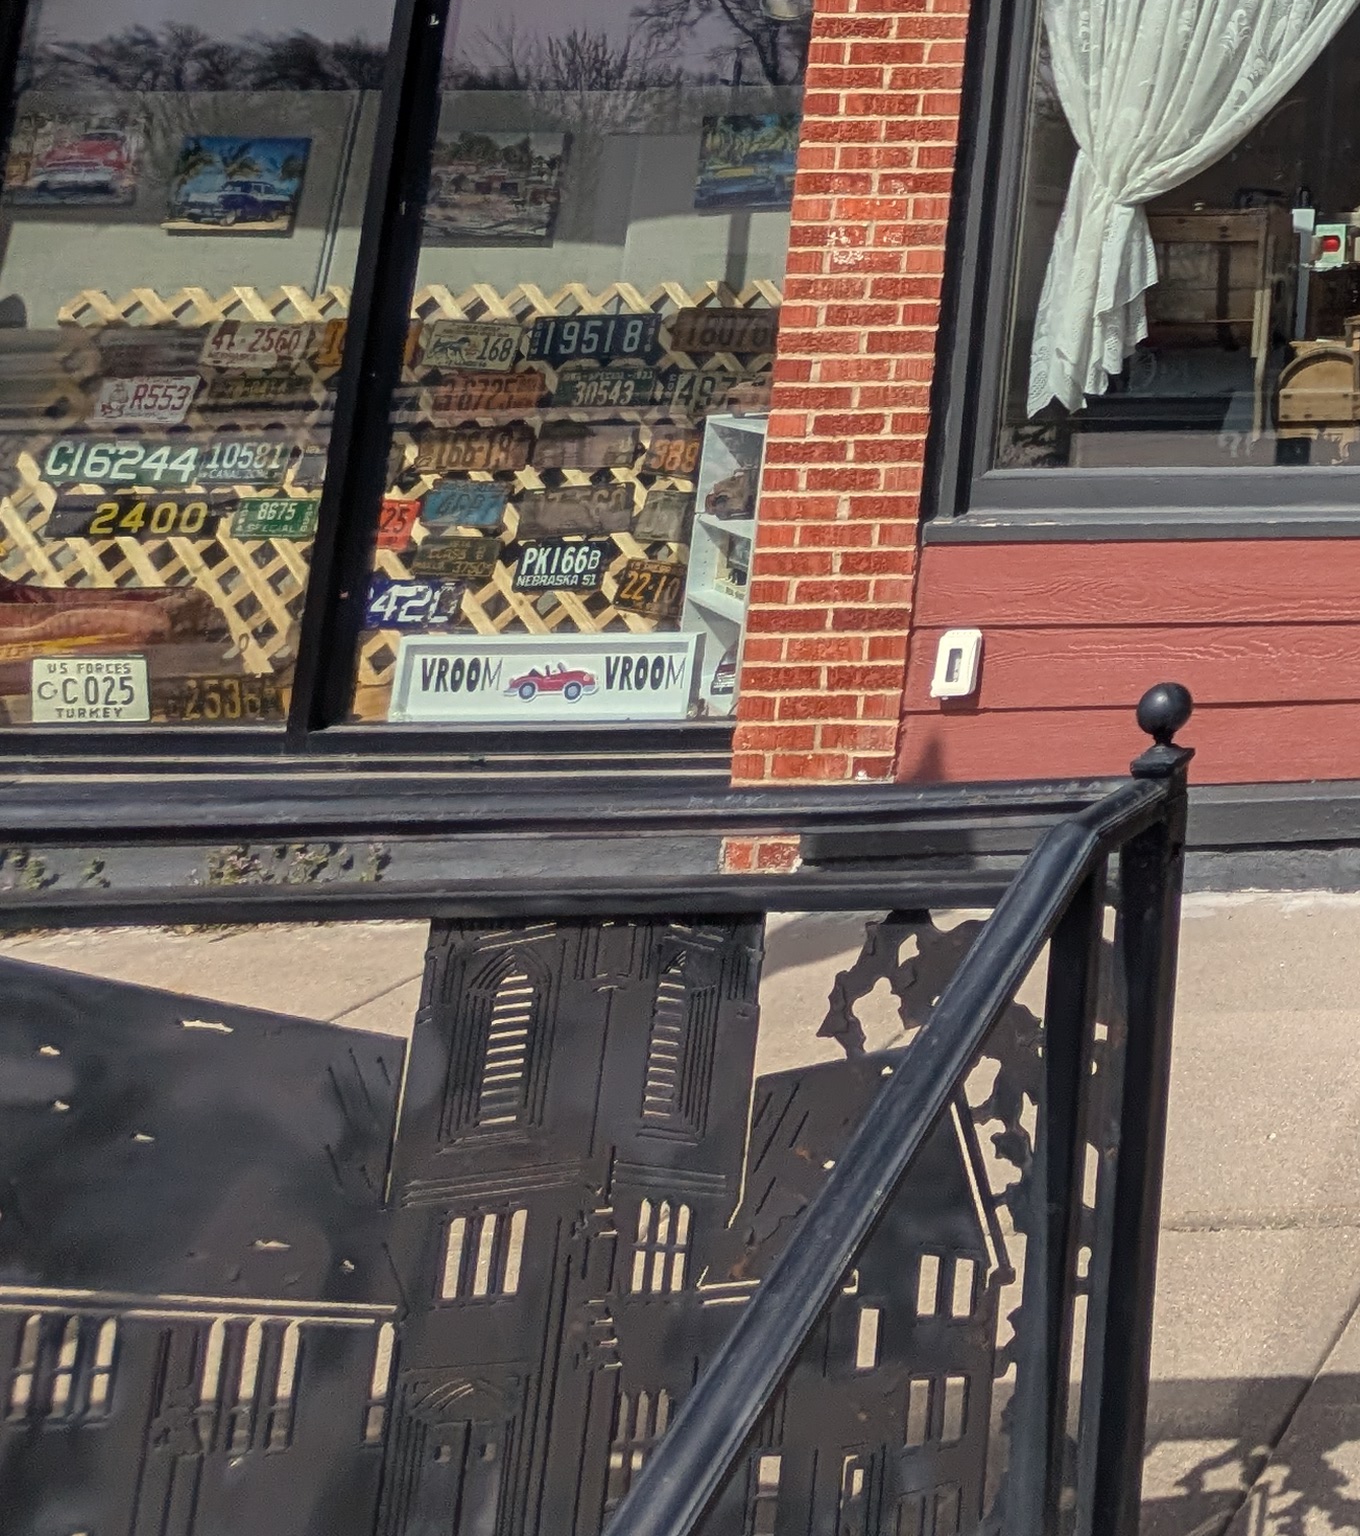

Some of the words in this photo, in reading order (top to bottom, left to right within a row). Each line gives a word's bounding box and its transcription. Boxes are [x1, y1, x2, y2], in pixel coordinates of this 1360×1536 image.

[476, 335, 514, 362] 168
[129, 383, 192, 411] R553
[205, 442, 285, 470] 10581
[89, 501, 208, 535] 2400
[257, 502, 298, 522] 8675
[521, 545, 602, 576] PK166B
[516, 574, 579, 588] NEBRASKA
[581, 574, 598, 587] 51
[48, 663, 68, 675] US
[77, 662, 132, 675] FORCES
[421, 657, 503, 693] VROOM
[605, 655, 687, 691] VROOM
[55, 707, 123, 719] TURKEY
